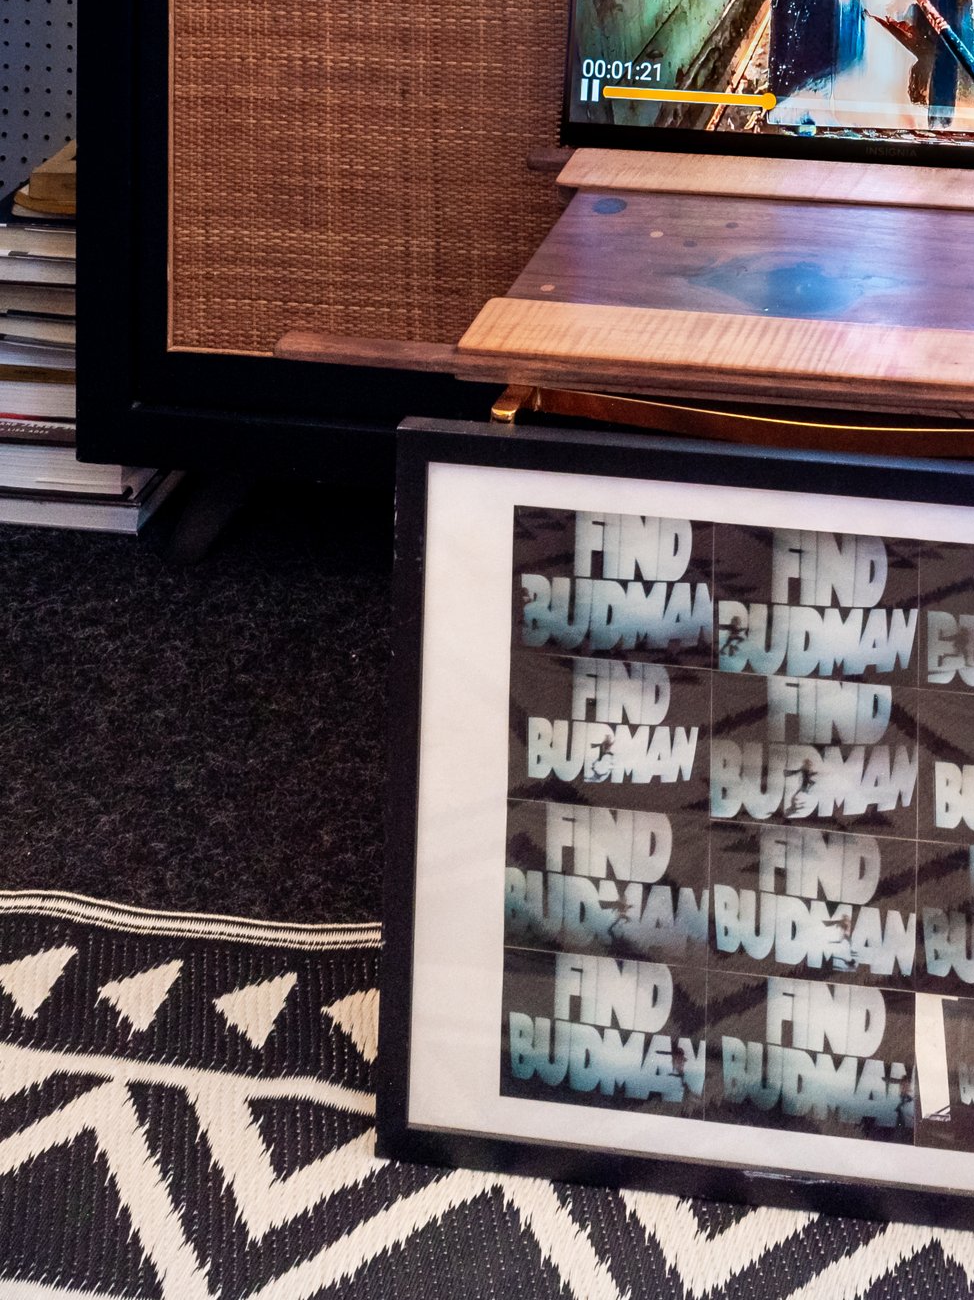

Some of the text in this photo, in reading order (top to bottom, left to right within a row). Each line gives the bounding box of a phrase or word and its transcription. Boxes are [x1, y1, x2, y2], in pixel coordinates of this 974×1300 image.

[582, 59, 662, 82] 00:01:21
[865, 146, 918, 157] INSIGNIA
[574, 510, 692, 582] FIND
[772, 528, 887, 609] FIND
[521, 574, 712, 649] BUDMAN
[718, 600, 918, 677] BUDMAN
[571, 658, 671, 726] FIND
[768, 675, 892, 745] FIND
[528, 717, 698, 785] BUDMAN
[711, 738, 918, 820] BUDMAN
[546, 803, 673, 884] FIND
[760, 827, 881, 906] FIND
[505, 867, 709, 946] BUDMAN
[714, 884, 916, 977] BUDMAN
[555, 953, 673, 1033] FIND
[766, 977, 886, 1058] FIND
